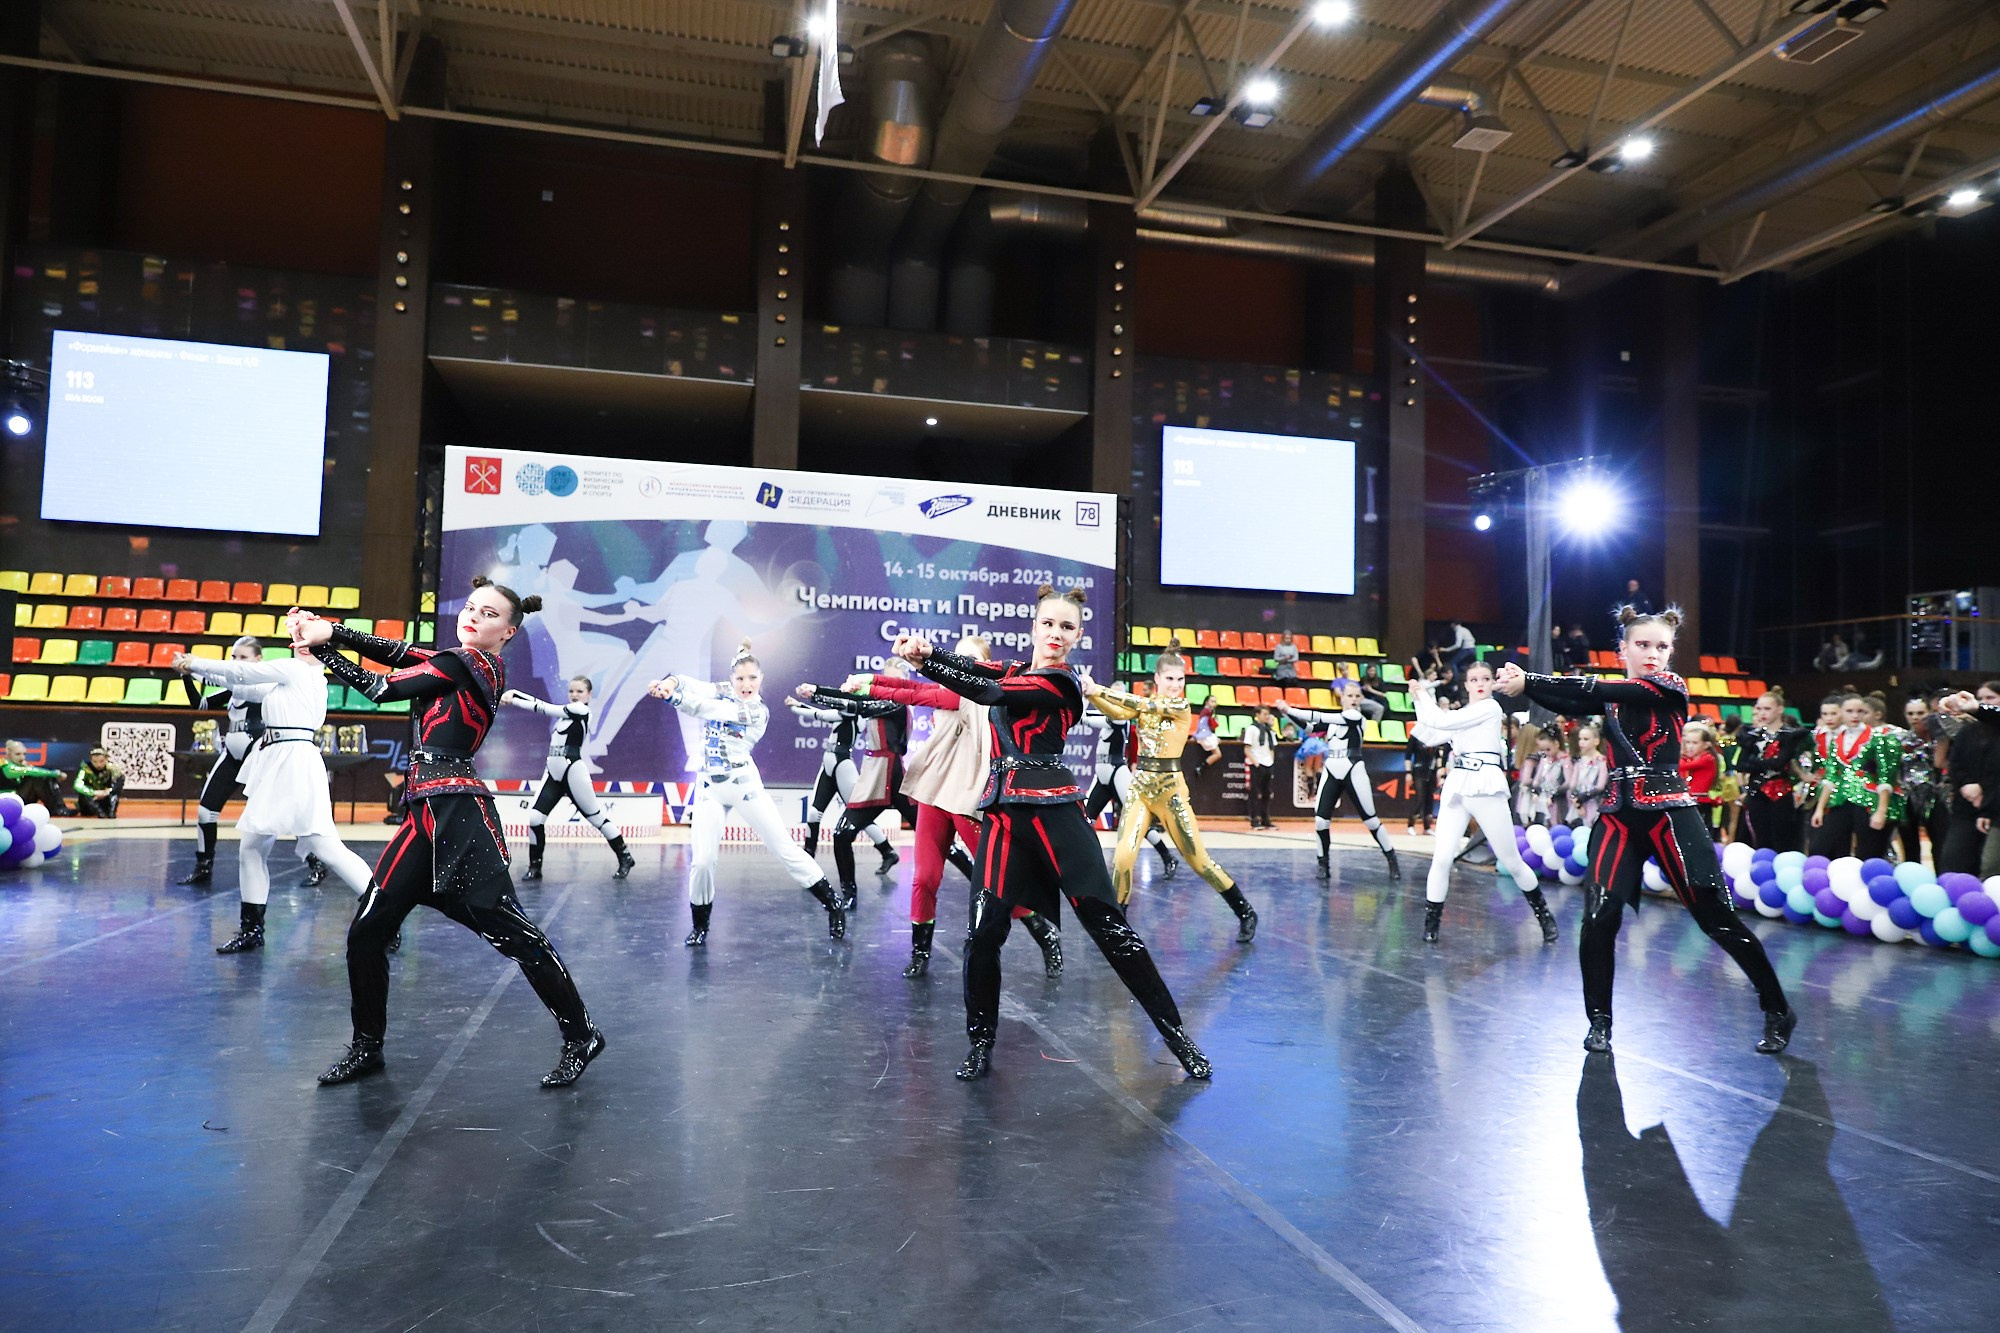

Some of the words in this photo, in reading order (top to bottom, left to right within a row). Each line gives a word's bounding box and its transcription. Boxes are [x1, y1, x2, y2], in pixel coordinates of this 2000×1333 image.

[66, 370, 94, 389] 113
[788, 495, 851, 508] ФЕДЕРАЦИЯ
[987, 505, 1061, 521] ДНЕВНИК
[1080, 507, 1096, 521] 78
[884, 561, 904, 577] 14
[917, 563, 935, 580] 15
[939, 567, 1009, 586] октября
[1013, 568, 1053, 585] 2023
[1057, 574, 1094, 590] года
[799, 586, 932, 614] Чемпионат
[937, 600, 951, 615] и
[856, 655, 885, 671] по
